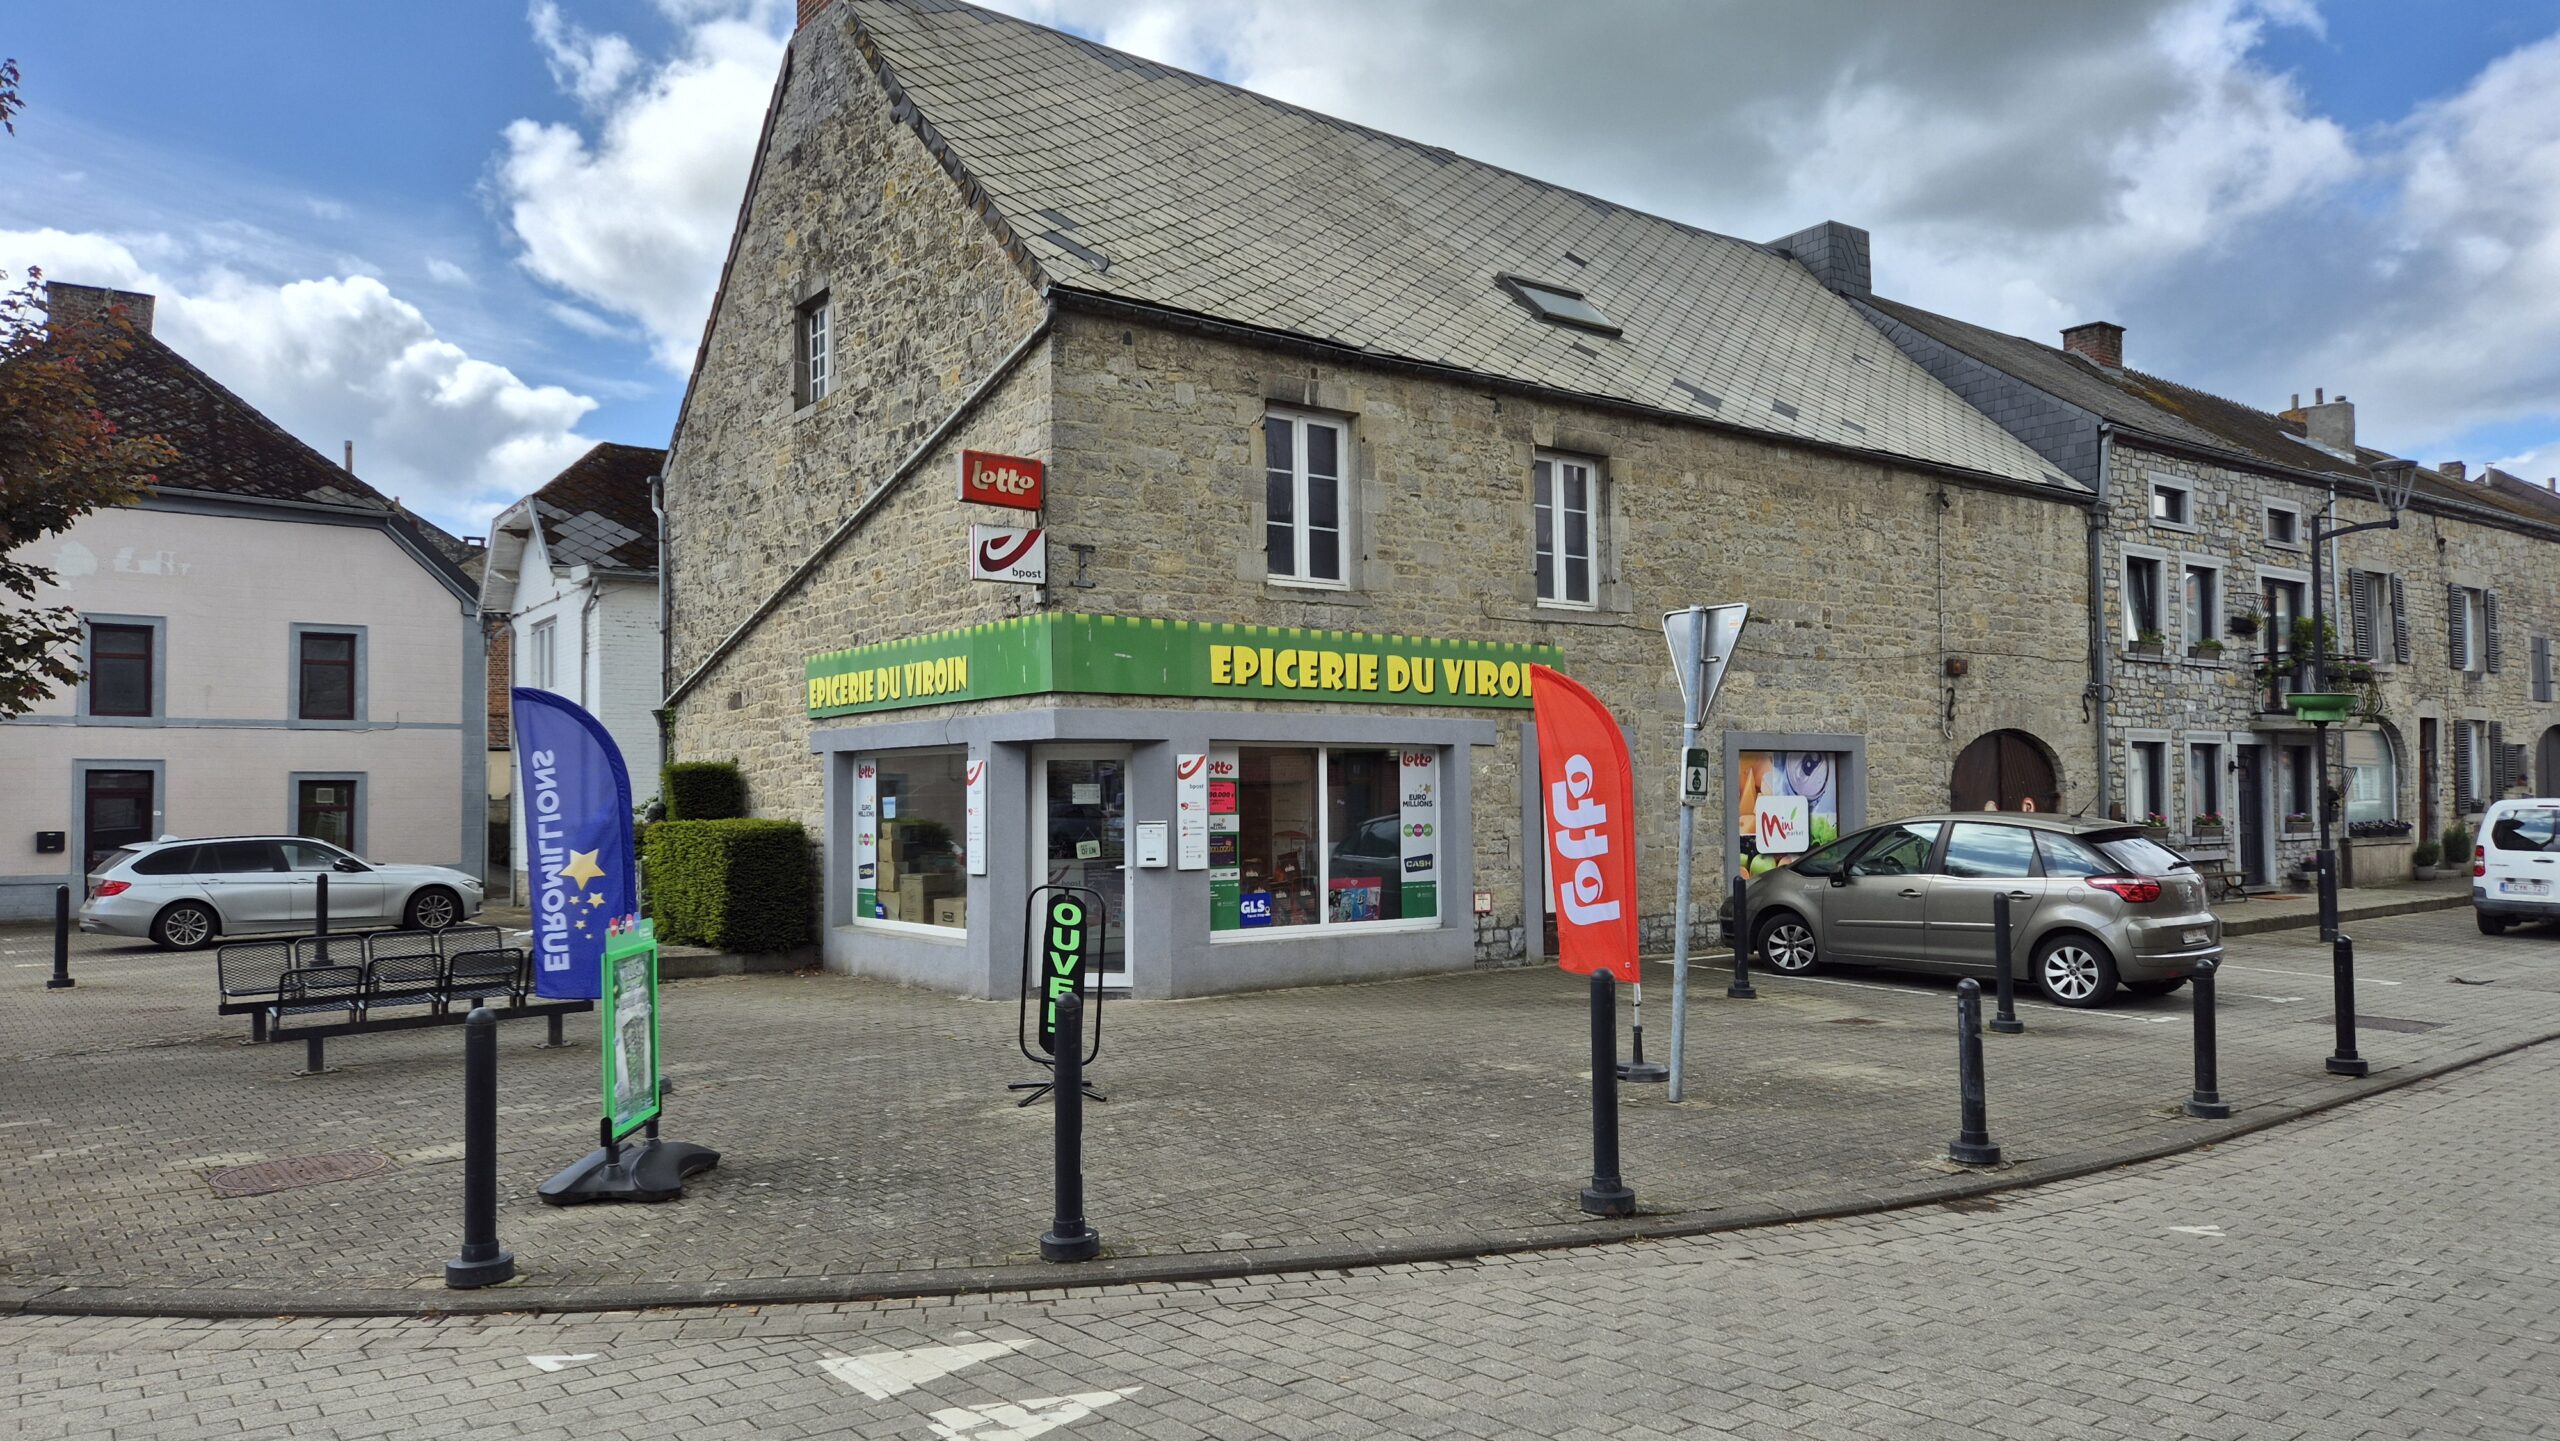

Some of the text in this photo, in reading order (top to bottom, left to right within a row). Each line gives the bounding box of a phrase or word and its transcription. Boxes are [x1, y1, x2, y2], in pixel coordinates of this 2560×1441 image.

[972, 460, 1035, 495] Lotto
[1012, 567, 1042, 579] bpost
[808, 655, 968, 710] EPICERIE DU VIROIN
[1209, 644, 1551, 698] EPICERIE DU VIROI
[1208, 761, 1233, 775] otto
[1761, 811, 1793, 848] Mini
[1406, 860, 1432, 868] CASH
[1240, 900, 1265, 914] GLS
[1047, 902, 1082, 1033] OUVE
